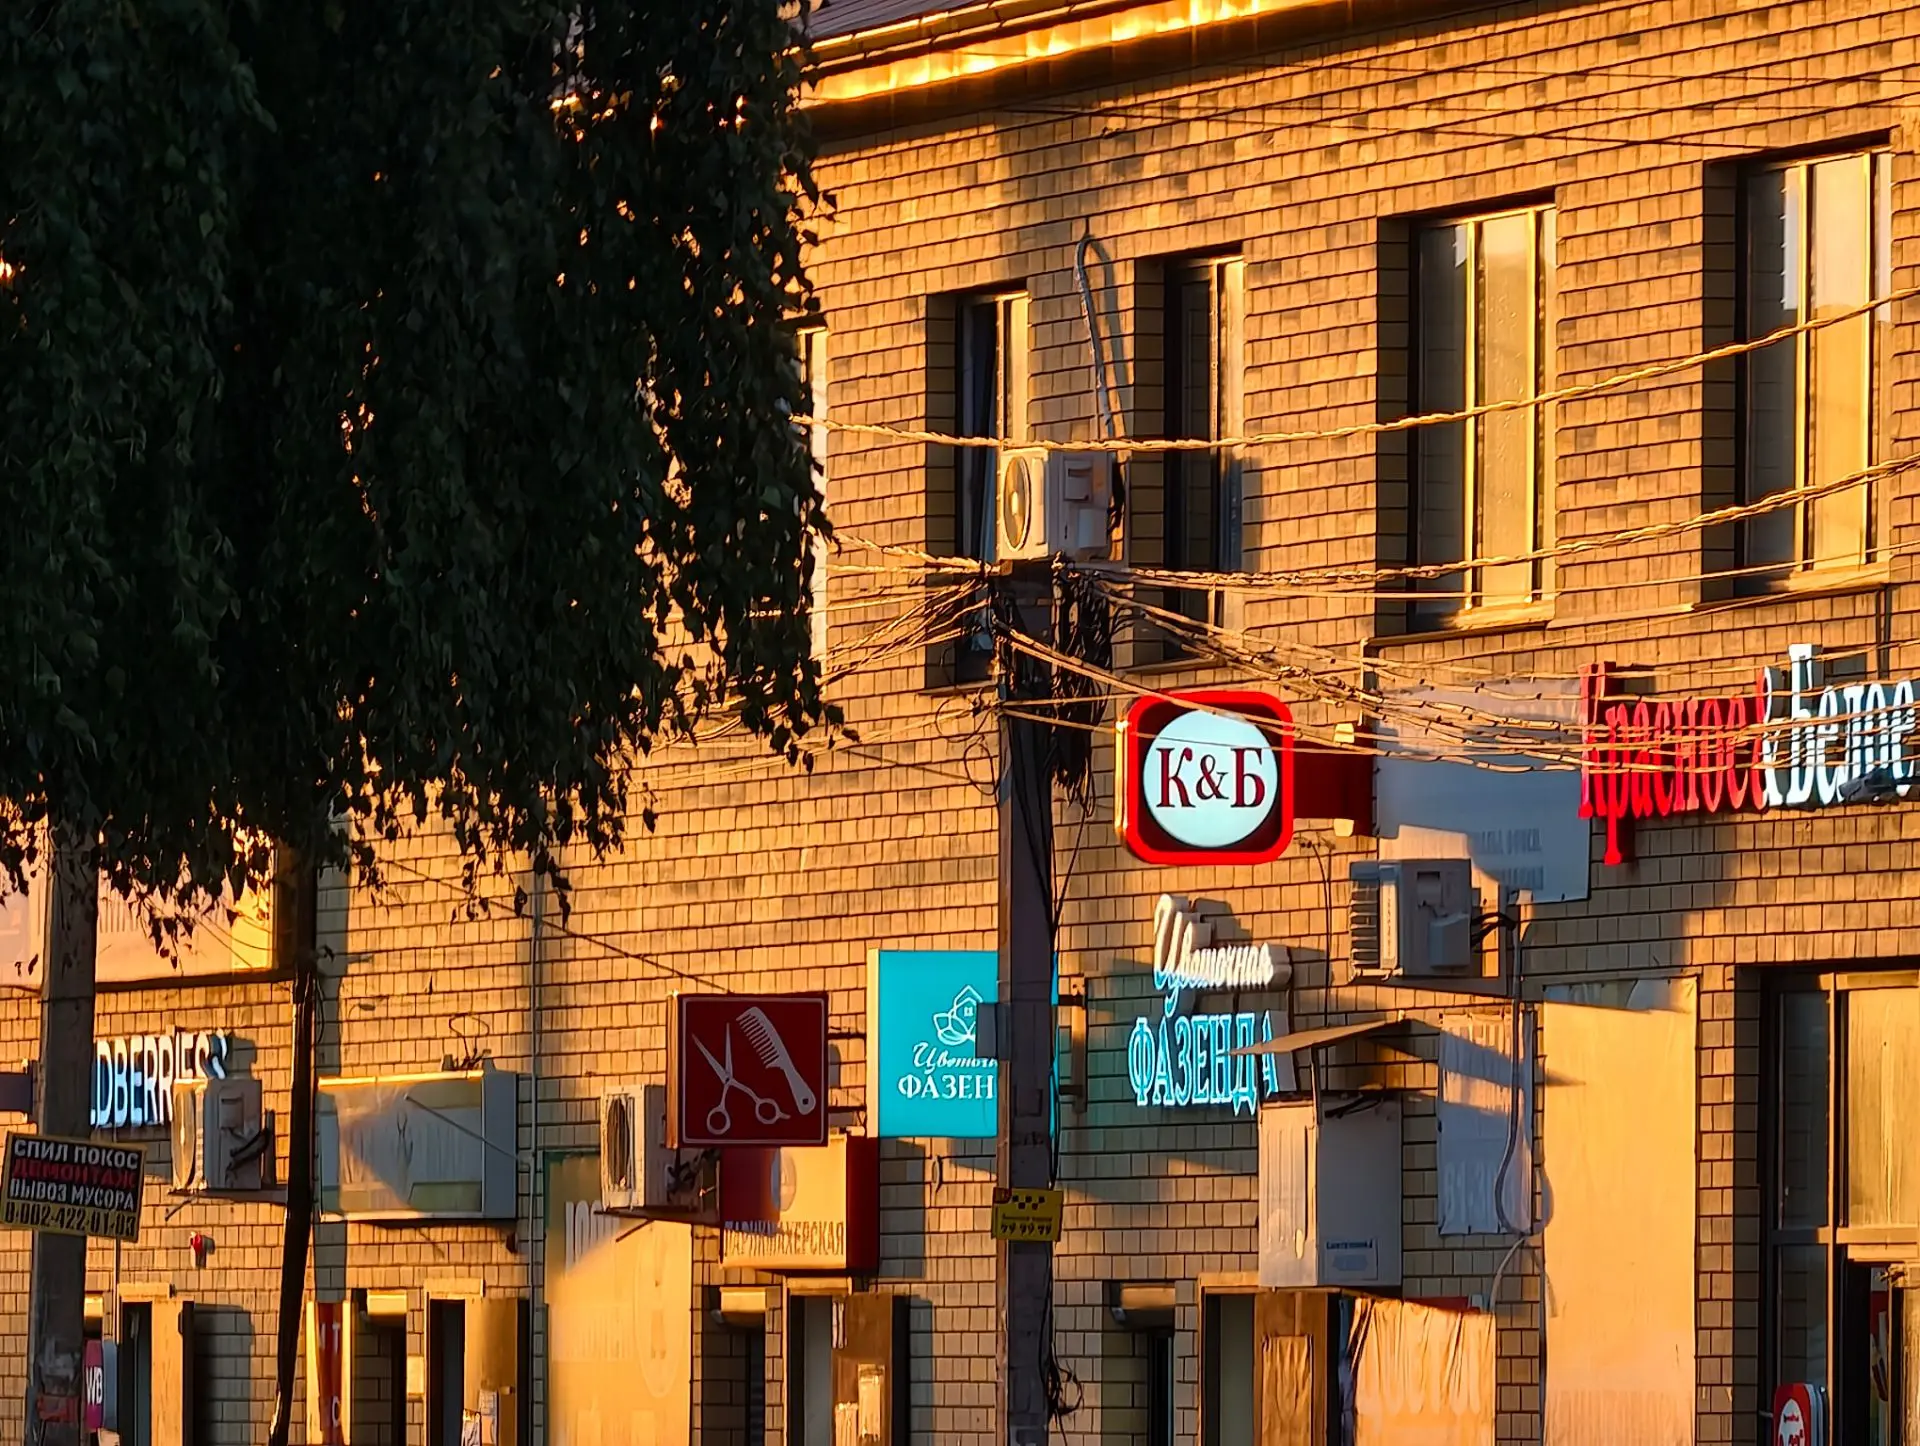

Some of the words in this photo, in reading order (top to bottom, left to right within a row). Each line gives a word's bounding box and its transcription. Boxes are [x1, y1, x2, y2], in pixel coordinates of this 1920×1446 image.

[1155, 747, 1266, 808] К&Б
[90, 1029, 227, 1128] DBERRIES
[1128, 1010, 1279, 1116] ФАЗЕНДА
[12, 1158, 138, 1190] ДЕМОНТАЖ
[14, 1139, 69, 1163] СПИЛ
[74, 1145, 139, 1170] ПОКОС
[9, 1178, 67, 1203] ВЫВОЗ
[71, 1185, 134, 1212] МУСОРА
[86, 1366, 103, 1407] WB
